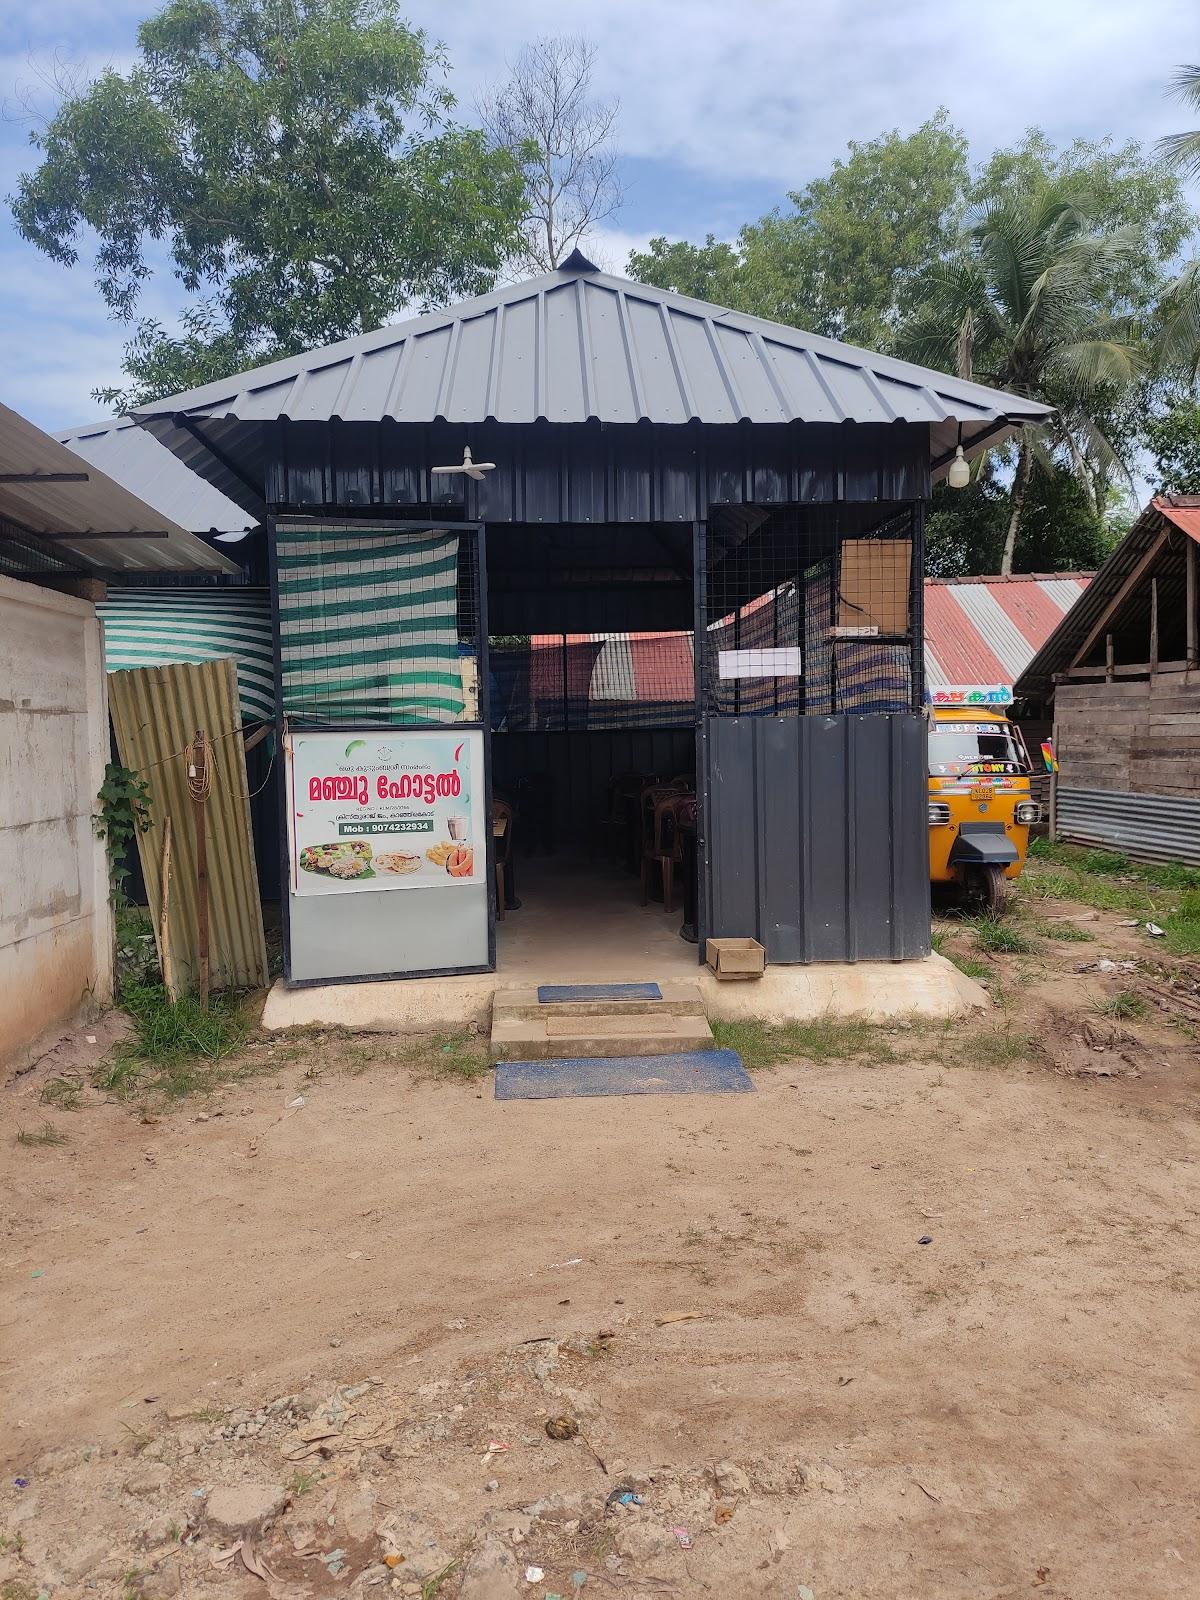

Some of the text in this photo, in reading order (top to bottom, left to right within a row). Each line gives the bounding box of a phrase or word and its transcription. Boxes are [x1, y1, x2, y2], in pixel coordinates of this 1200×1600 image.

[309, 769, 461, 805] മഞ്ചു ഹോട്ടൽ
[343, 824, 363, 833] Mob
[372, 822, 429, 833] 9074232934
